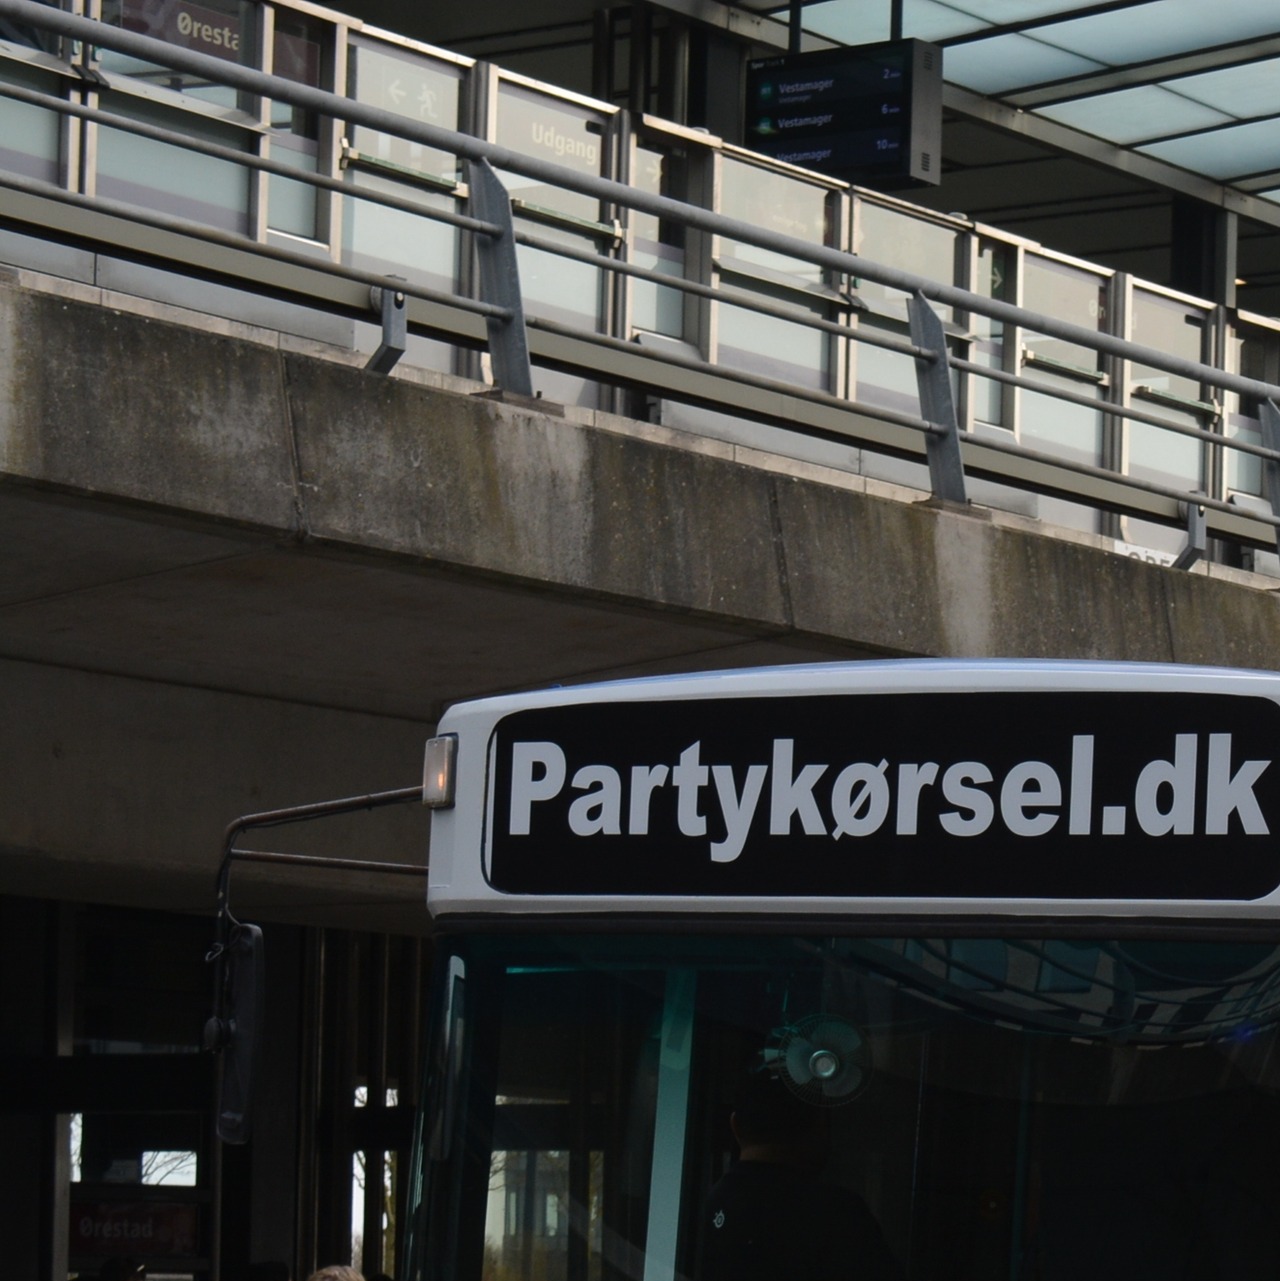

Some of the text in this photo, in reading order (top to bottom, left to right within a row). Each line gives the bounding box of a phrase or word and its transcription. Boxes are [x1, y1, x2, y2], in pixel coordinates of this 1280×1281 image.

[177, 11, 240, 51] Øresta
[778, 78, 834, 95] Vestamager
[883, 69, 890, 79] 2
[778, 112, 833, 129] Vestamager
[881, 104, 888, 114] 6
[531, 121, 598, 166] Udgang
[876, 140, 887, 150] 10
[508, 732, 1271, 863] Partykørsel.dk
[79, 1216, 153, 1238] Ørestad
